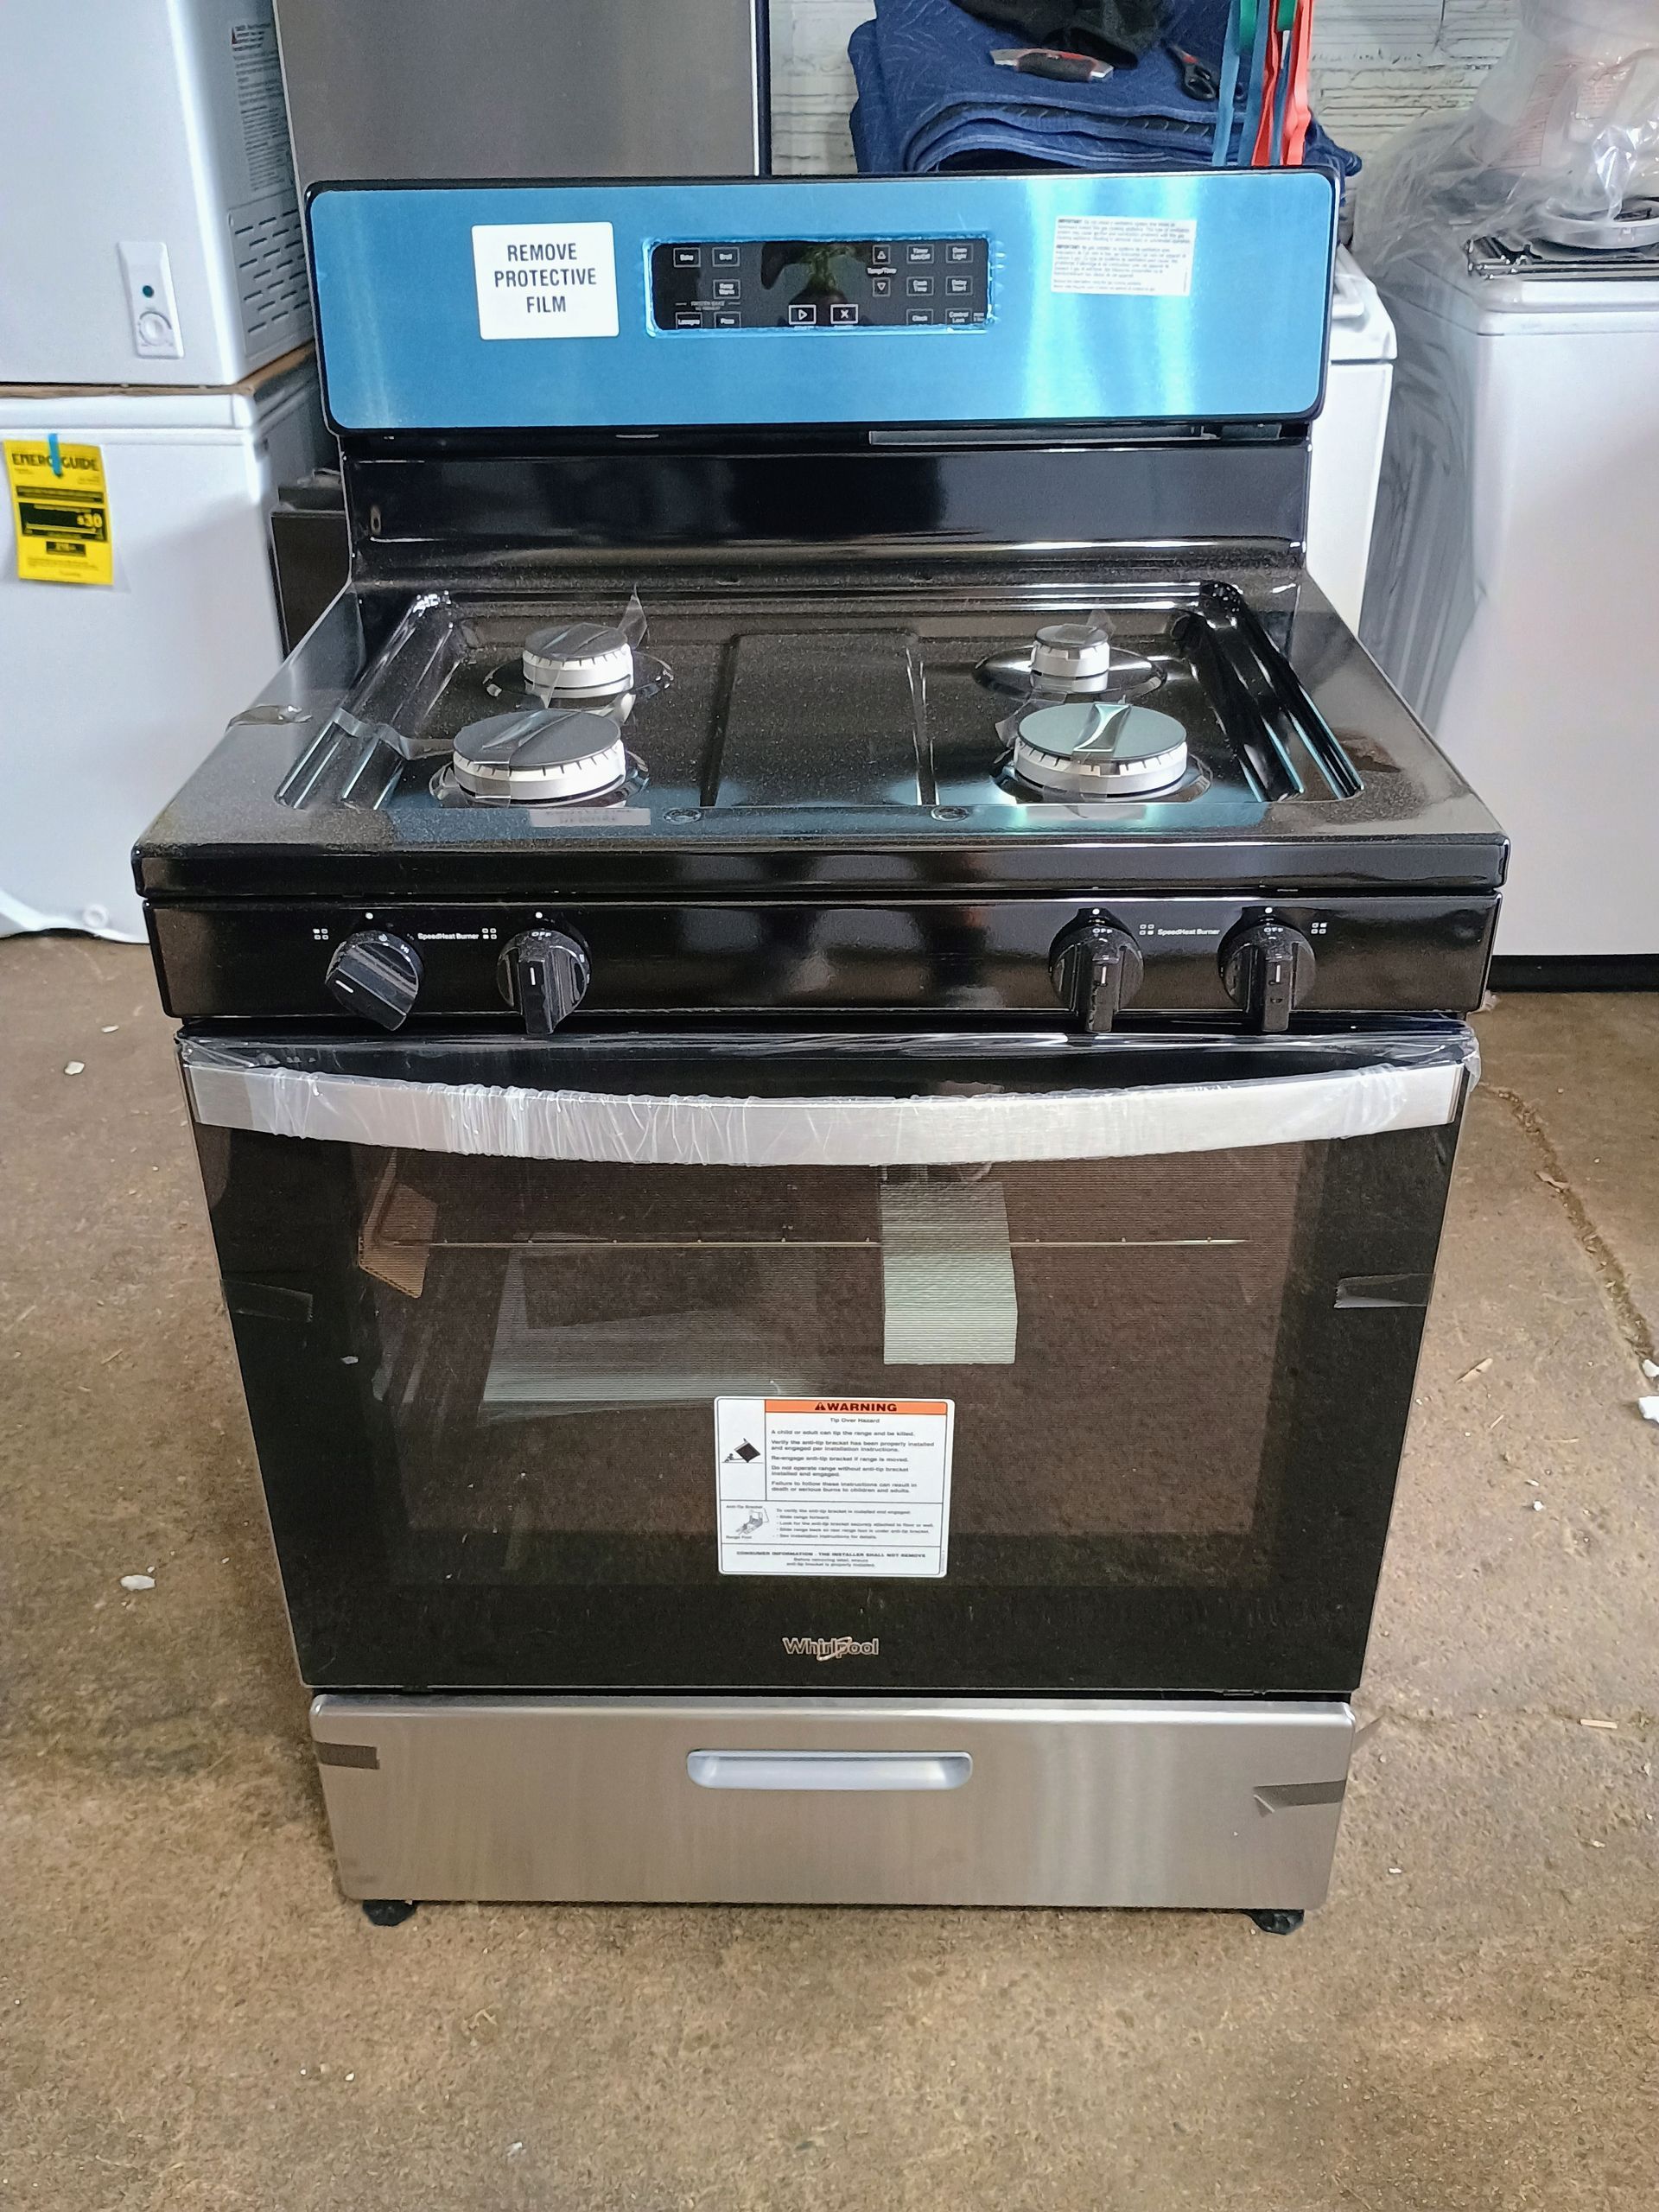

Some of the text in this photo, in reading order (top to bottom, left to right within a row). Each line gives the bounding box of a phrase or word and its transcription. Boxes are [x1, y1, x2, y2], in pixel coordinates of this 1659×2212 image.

[507, 243, 577, 262] REMOVE
[494, 268, 597, 288] PROTECTIVE
[526, 296, 567, 314] FILM
[827, 1402, 897, 1411] WARNING
[782, 1637, 880, 1659] Whirlpool
